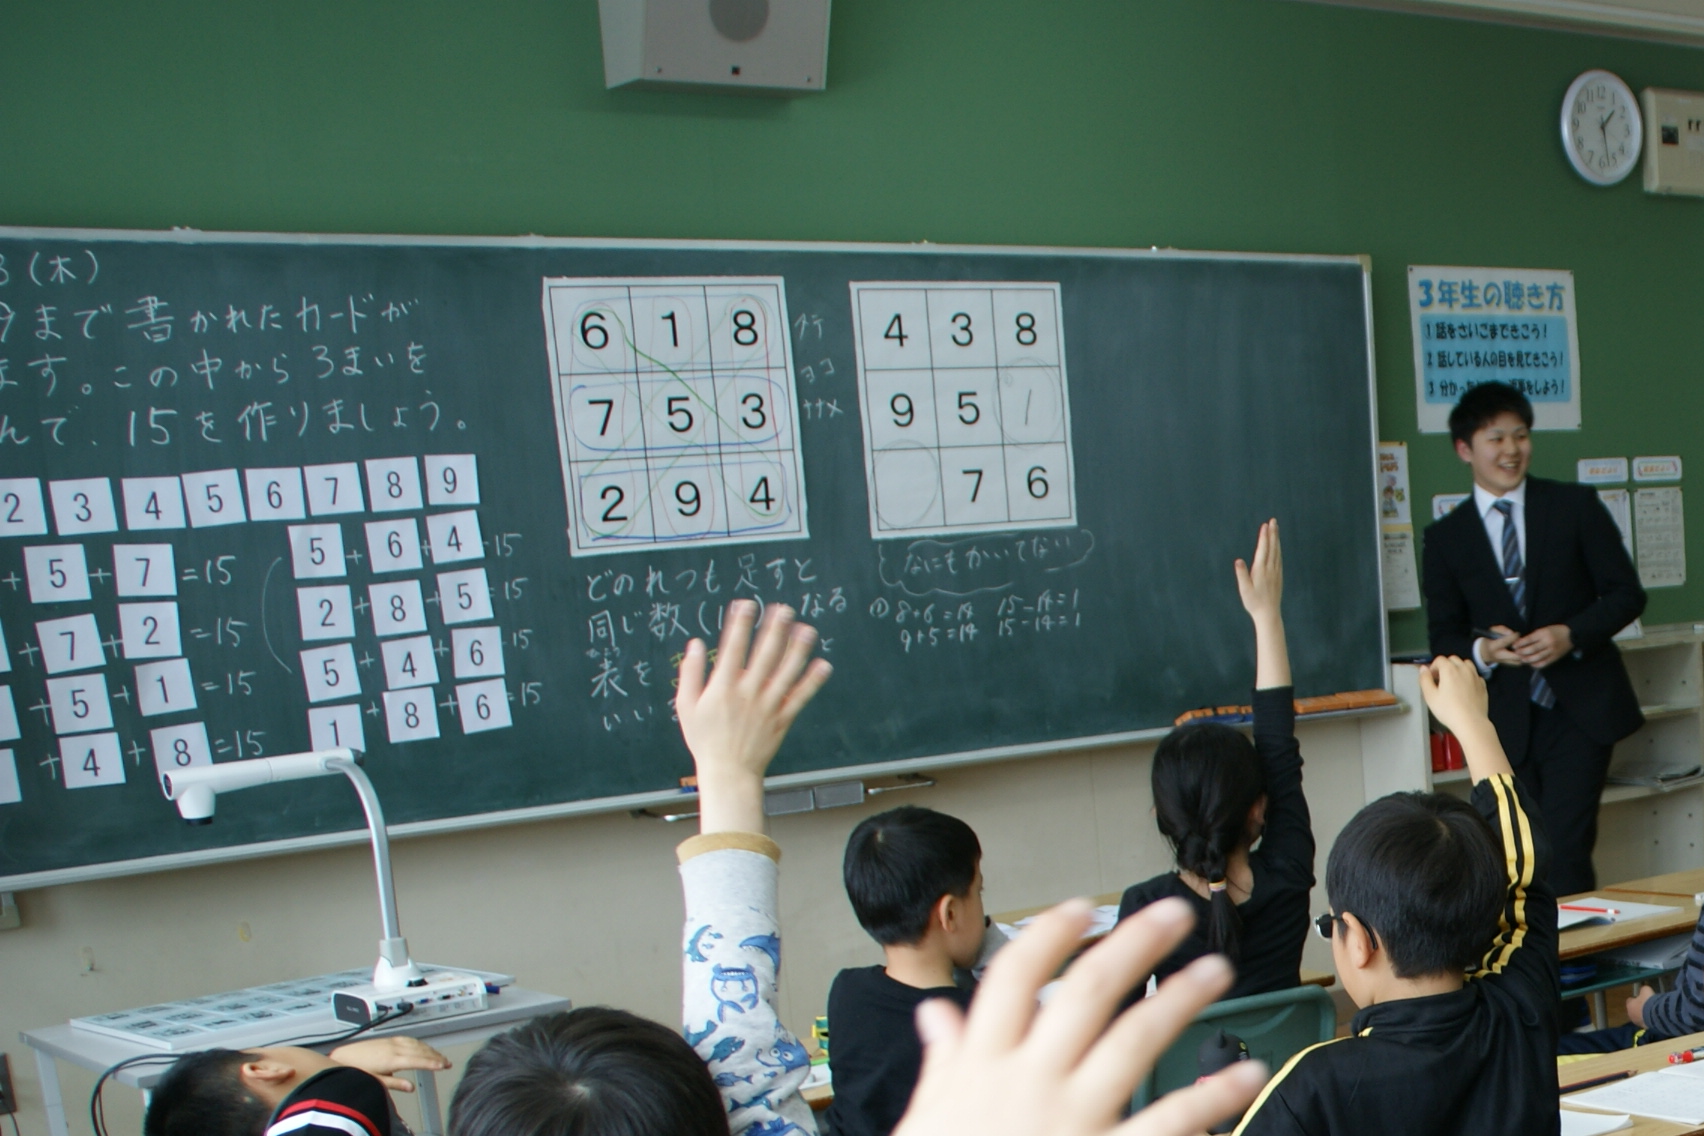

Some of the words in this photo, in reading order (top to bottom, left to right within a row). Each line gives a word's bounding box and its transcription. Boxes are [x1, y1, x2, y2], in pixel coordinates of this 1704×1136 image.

[1577, 103, 1586, 114] 10
[1586, 89, 1594, 102] 11
[1597, 86, 1606, 99] 12
[1612, 92, 1615, 104] 1
[1573, 118, 1579, 131] 9
[1620, 105, 1626, 119] 2
[1578, 138, 1584, 149] 8
[1625, 124, 1630, 137] 3
[1588, 151, 1594, 164] 7
[1599, 157, 1605, 168] 6
[1612, 153, 1617, 166] 5
[1619, 145, 1624, 155] 4
[1419, 279, 1565, 311] 3年生の聴き方
[581, 311, 609, 349] 6
[661, 311, 678, 347] 1
[733, 310, 758, 346] 8
[884, 313, 908, 347] 4
[951, 312, 973, 347] 3
[1015, 312, 1037, 346] 8
[588, 400, 613, 436] 7
[667, 396, 694, 433] 5
[742, 393, 766, 429] 3
[890, 393, 914, 427] 9
[958, 391, 980, 425] 5
[4, 493, 23, 522] 2
[73, 493, 92, 522] 3
[145, 492, 162, 520] 4
[206, 484, 223, 513] 5
[267, 481, 283, 509] 6
[324, 477, 339, 505] 7
[387, 471, 403, 499] 8
[443, 467, 457, 494] 9
[601, 485, 627, 522] 2
[675, 481, 701, 516] 9
[749, 476, 775, 510] 4
[962, 469, 983, 502] 7
[1027, 466, 1049, 499] 6
[310, 537, 325, 565] 5
[388, 531, 403, 558] 6
[448, 525, 463, 552] 4
[49, 559, 67, 588] 5
[135, 557, 150, 587] 7
[587, 553, 817, 601] どのれつも足すと
[319, 599, 335, 627] 2
[390, 595, 406, 622] 8
[457, 583, 472, 609] 5
[59, 631, 76, 661] 7
[143, 616, 161, 645] 2
[323, 659, 339, 687] 5
[402, 651, 417, 678] 4
[470, 639, 485, 666] 6
[591, 658, 651, 698] 表を
[71, 689, 90, 718] 5
[156, 675, 169, 704] 1
[329, 719, 340, 747] 1
[404, 702, 420, 729] 8
[476, 694, 491, 720] 6
[83, 748, 101, 777] 4
[173, 738, 192, 767] 8
